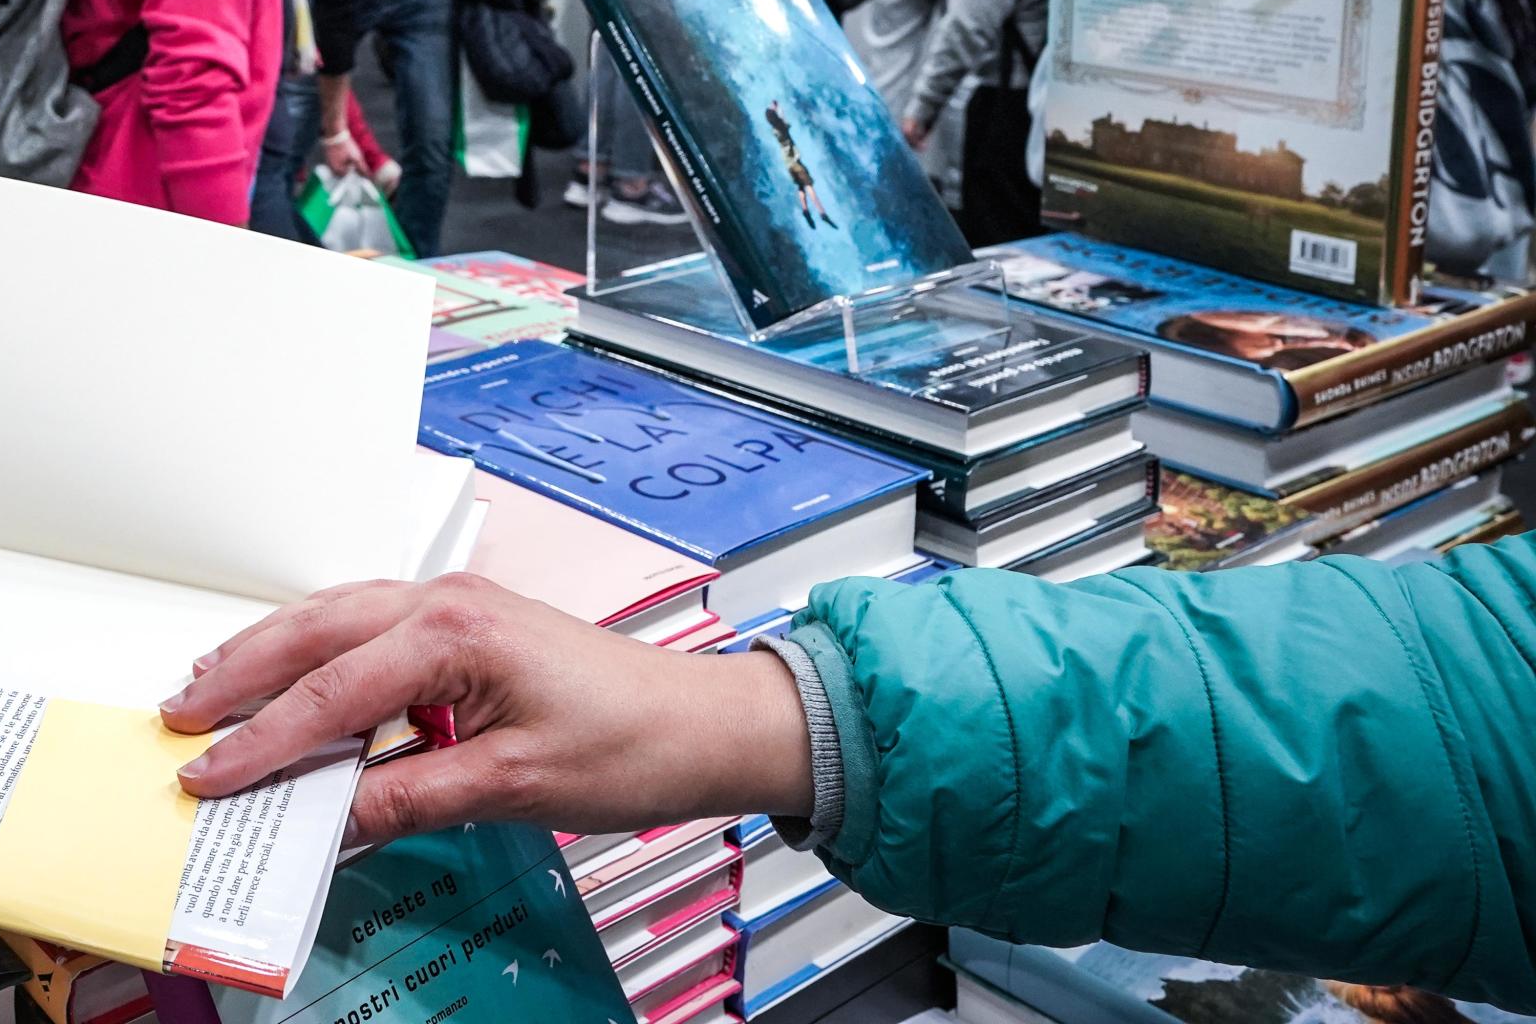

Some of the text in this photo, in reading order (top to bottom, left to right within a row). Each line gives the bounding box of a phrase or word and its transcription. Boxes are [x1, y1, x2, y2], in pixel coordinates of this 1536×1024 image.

[1410, 61, 1440, 247] BRIDGERTON
[628, 428, 818, 501] COLPA
[258, 796, 274, 820] nostri
[244, 826, 262, 858] scontati
[268, 819, 282, 840] unici
[184, 893, 200, 914] vuol
[192, 875, 206, 893] dire
[202, 848, 218, 874] amare
[221, 807, 234, 828] certo
[188, 837, 205, 863] avanti
[202, 884, 221, 918] quando
[218, 858, 232, 874] vita
[230, 833, 242, 847] già
[236, 804, 253, 832] colpito
[256, 841, 275, 875] speciali,
[237, 859, 249, 875] per
[227, 875, 243, 896] dare
[241, 876, 261, 904] invece
[222, 897, 235, 915] non
[234, 905, 250, 927] derli
[351, 872, 457, 945] celeste ng
[405, 944, 457, 992] cuori
[461, 897, 529, 963] perduti
